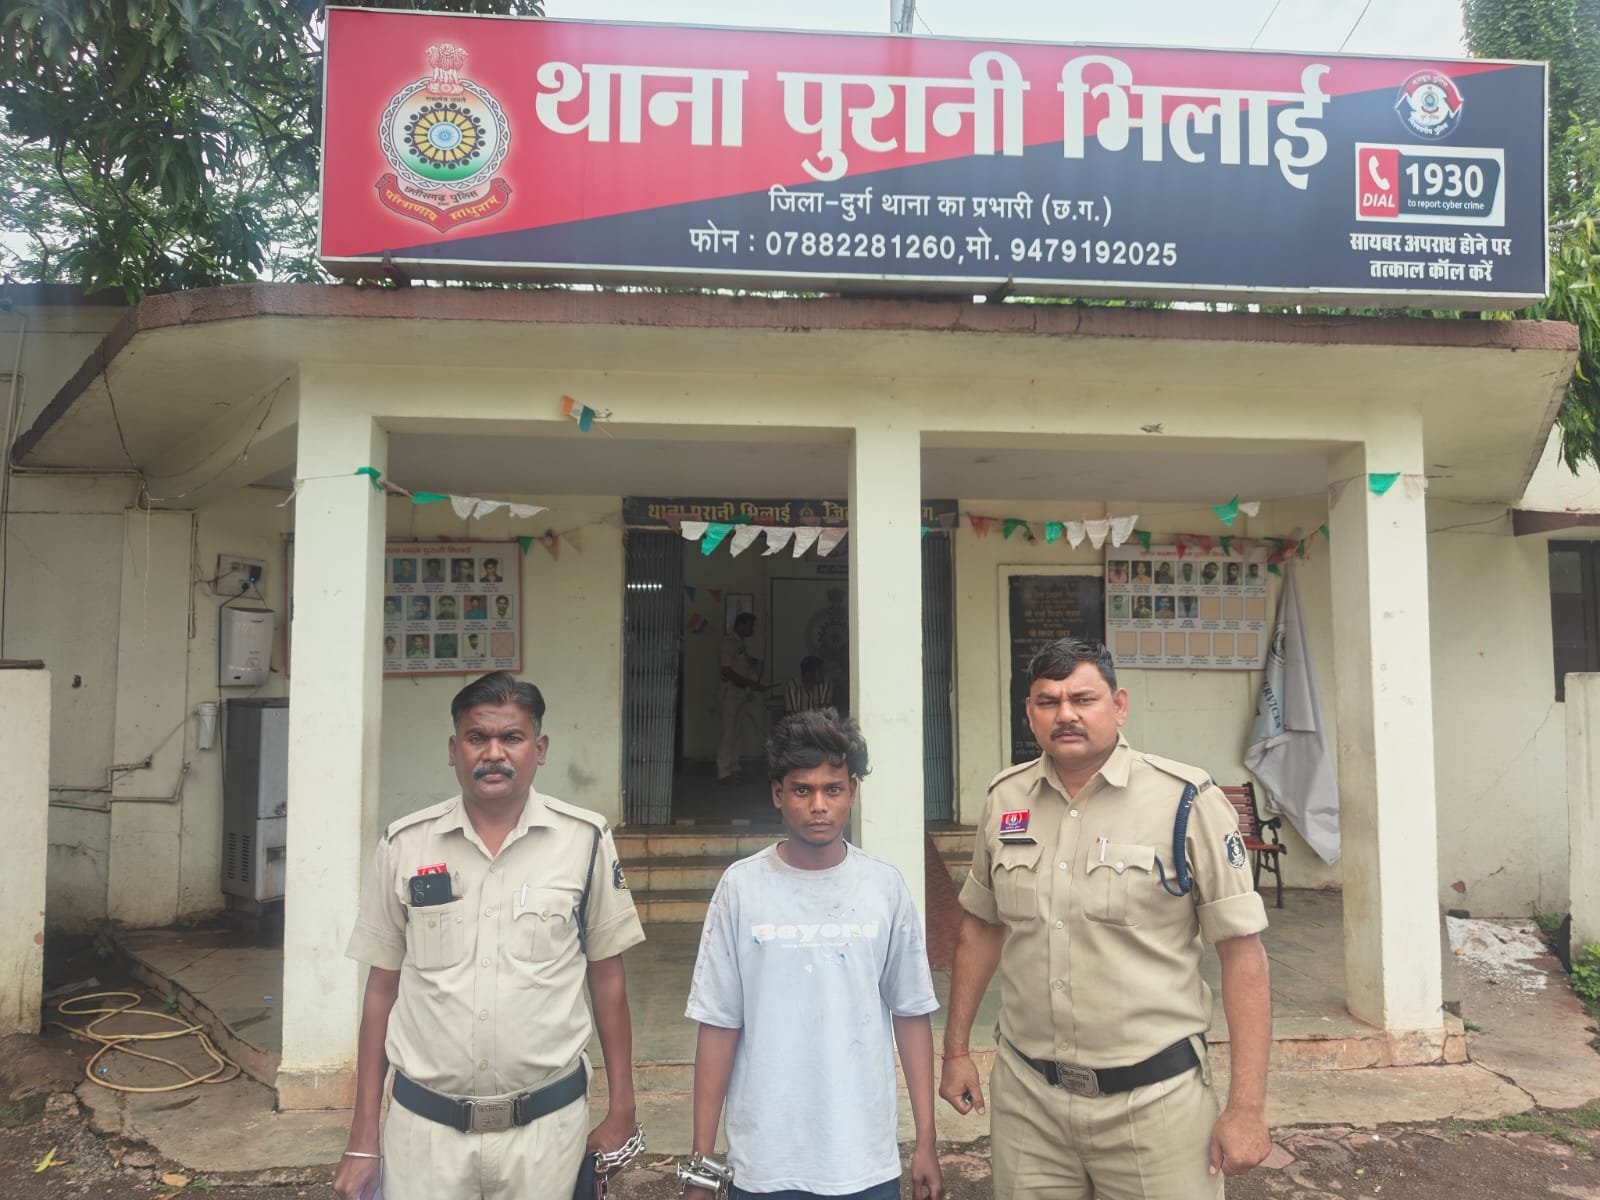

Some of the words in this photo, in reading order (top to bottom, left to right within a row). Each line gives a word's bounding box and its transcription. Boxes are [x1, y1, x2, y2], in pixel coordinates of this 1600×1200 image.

[535, 61, 749, 148] थाना
[777, 51, 1031, 182] पुरानी
[1057, 54, 1331, 190] भिलाई
[1405, 163, 1484, 198] 1930
[450, 190, 479, 203] पुलिस
[768, 184, 873, 222] जिला-दुर्ग
[882, 195, 930, 216] थाना
[937, 196, 966, 217] का
[972, 191, 1034, 219] प्रभारी
[1042, 193, 1112, 227] (छ.ग.)
[1362, 193, 1395, 208] DIAL
[1407, 199, 1416, 207] to
[1417, 201, 1441, 211] report
[1442, 201, 1462, 212] cyber
[1463, 202, 1485, 210] crime
[689, 219, 740, 254] फोन
[1010, 238, 1177, 266] 9479192025
[1349, 233, 1402, 252] सायबर
[1404, 235, 1457, 254] अपराध
[1459, 233, 1488, 255] होने
[1491, 238, 1512, 255] पर
[1370, 261, 1425, 279] तत्काल
[1428, 258, 1466, 281] कॉल
[1468, 259, 1494, 281] करें
[1262, 680, 1282, 729] ERVICES
